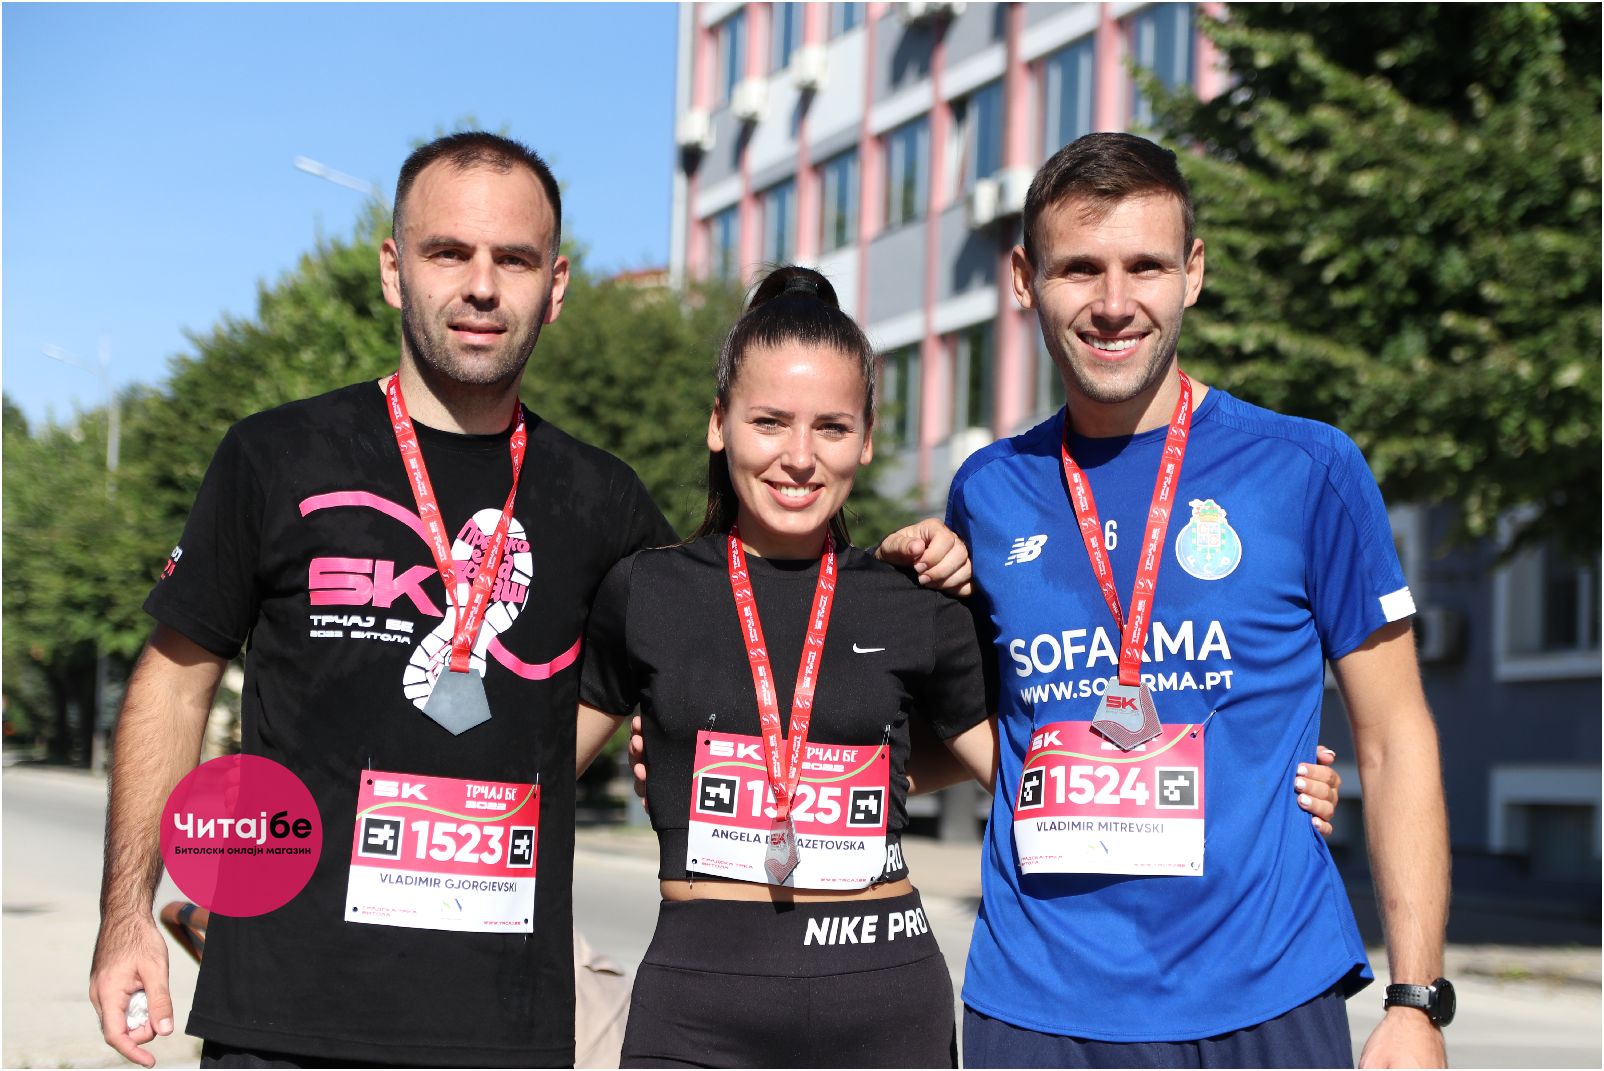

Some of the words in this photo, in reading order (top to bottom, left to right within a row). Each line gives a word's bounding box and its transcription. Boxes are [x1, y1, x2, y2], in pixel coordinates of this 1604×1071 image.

[1104, 519, 1118, 551] 6
[310, 615, 375, 627] ТРЧАЈ
[709, 740, 763, 761] 5K
[804, 746, 840, 762] РЧАЈ
[842, 750, 858, 763] БЕ
[373, 780, 428, 800] 5K
[466, 784, 502, 800] ТРЧАЈ
[505, 788, 517, 801] БЕ
[1050, 765, 1150, 806] 1524
[465, 800, 507, 811] 2022
[712, 828, 762, 844] ANGELA
[1036, 821, 1094, 832] VLADIMIR
[1098, 822, 1164, 833] MITREVSKI
[411, 820, 505, 865] 1523
[380, 873, 440, 888] VLADIMIR
[445, 878, 517, 893] GJORGIEVSKI
[804, 916, 879, 946] NIKE
[888, 907, 929, 941] PRO
